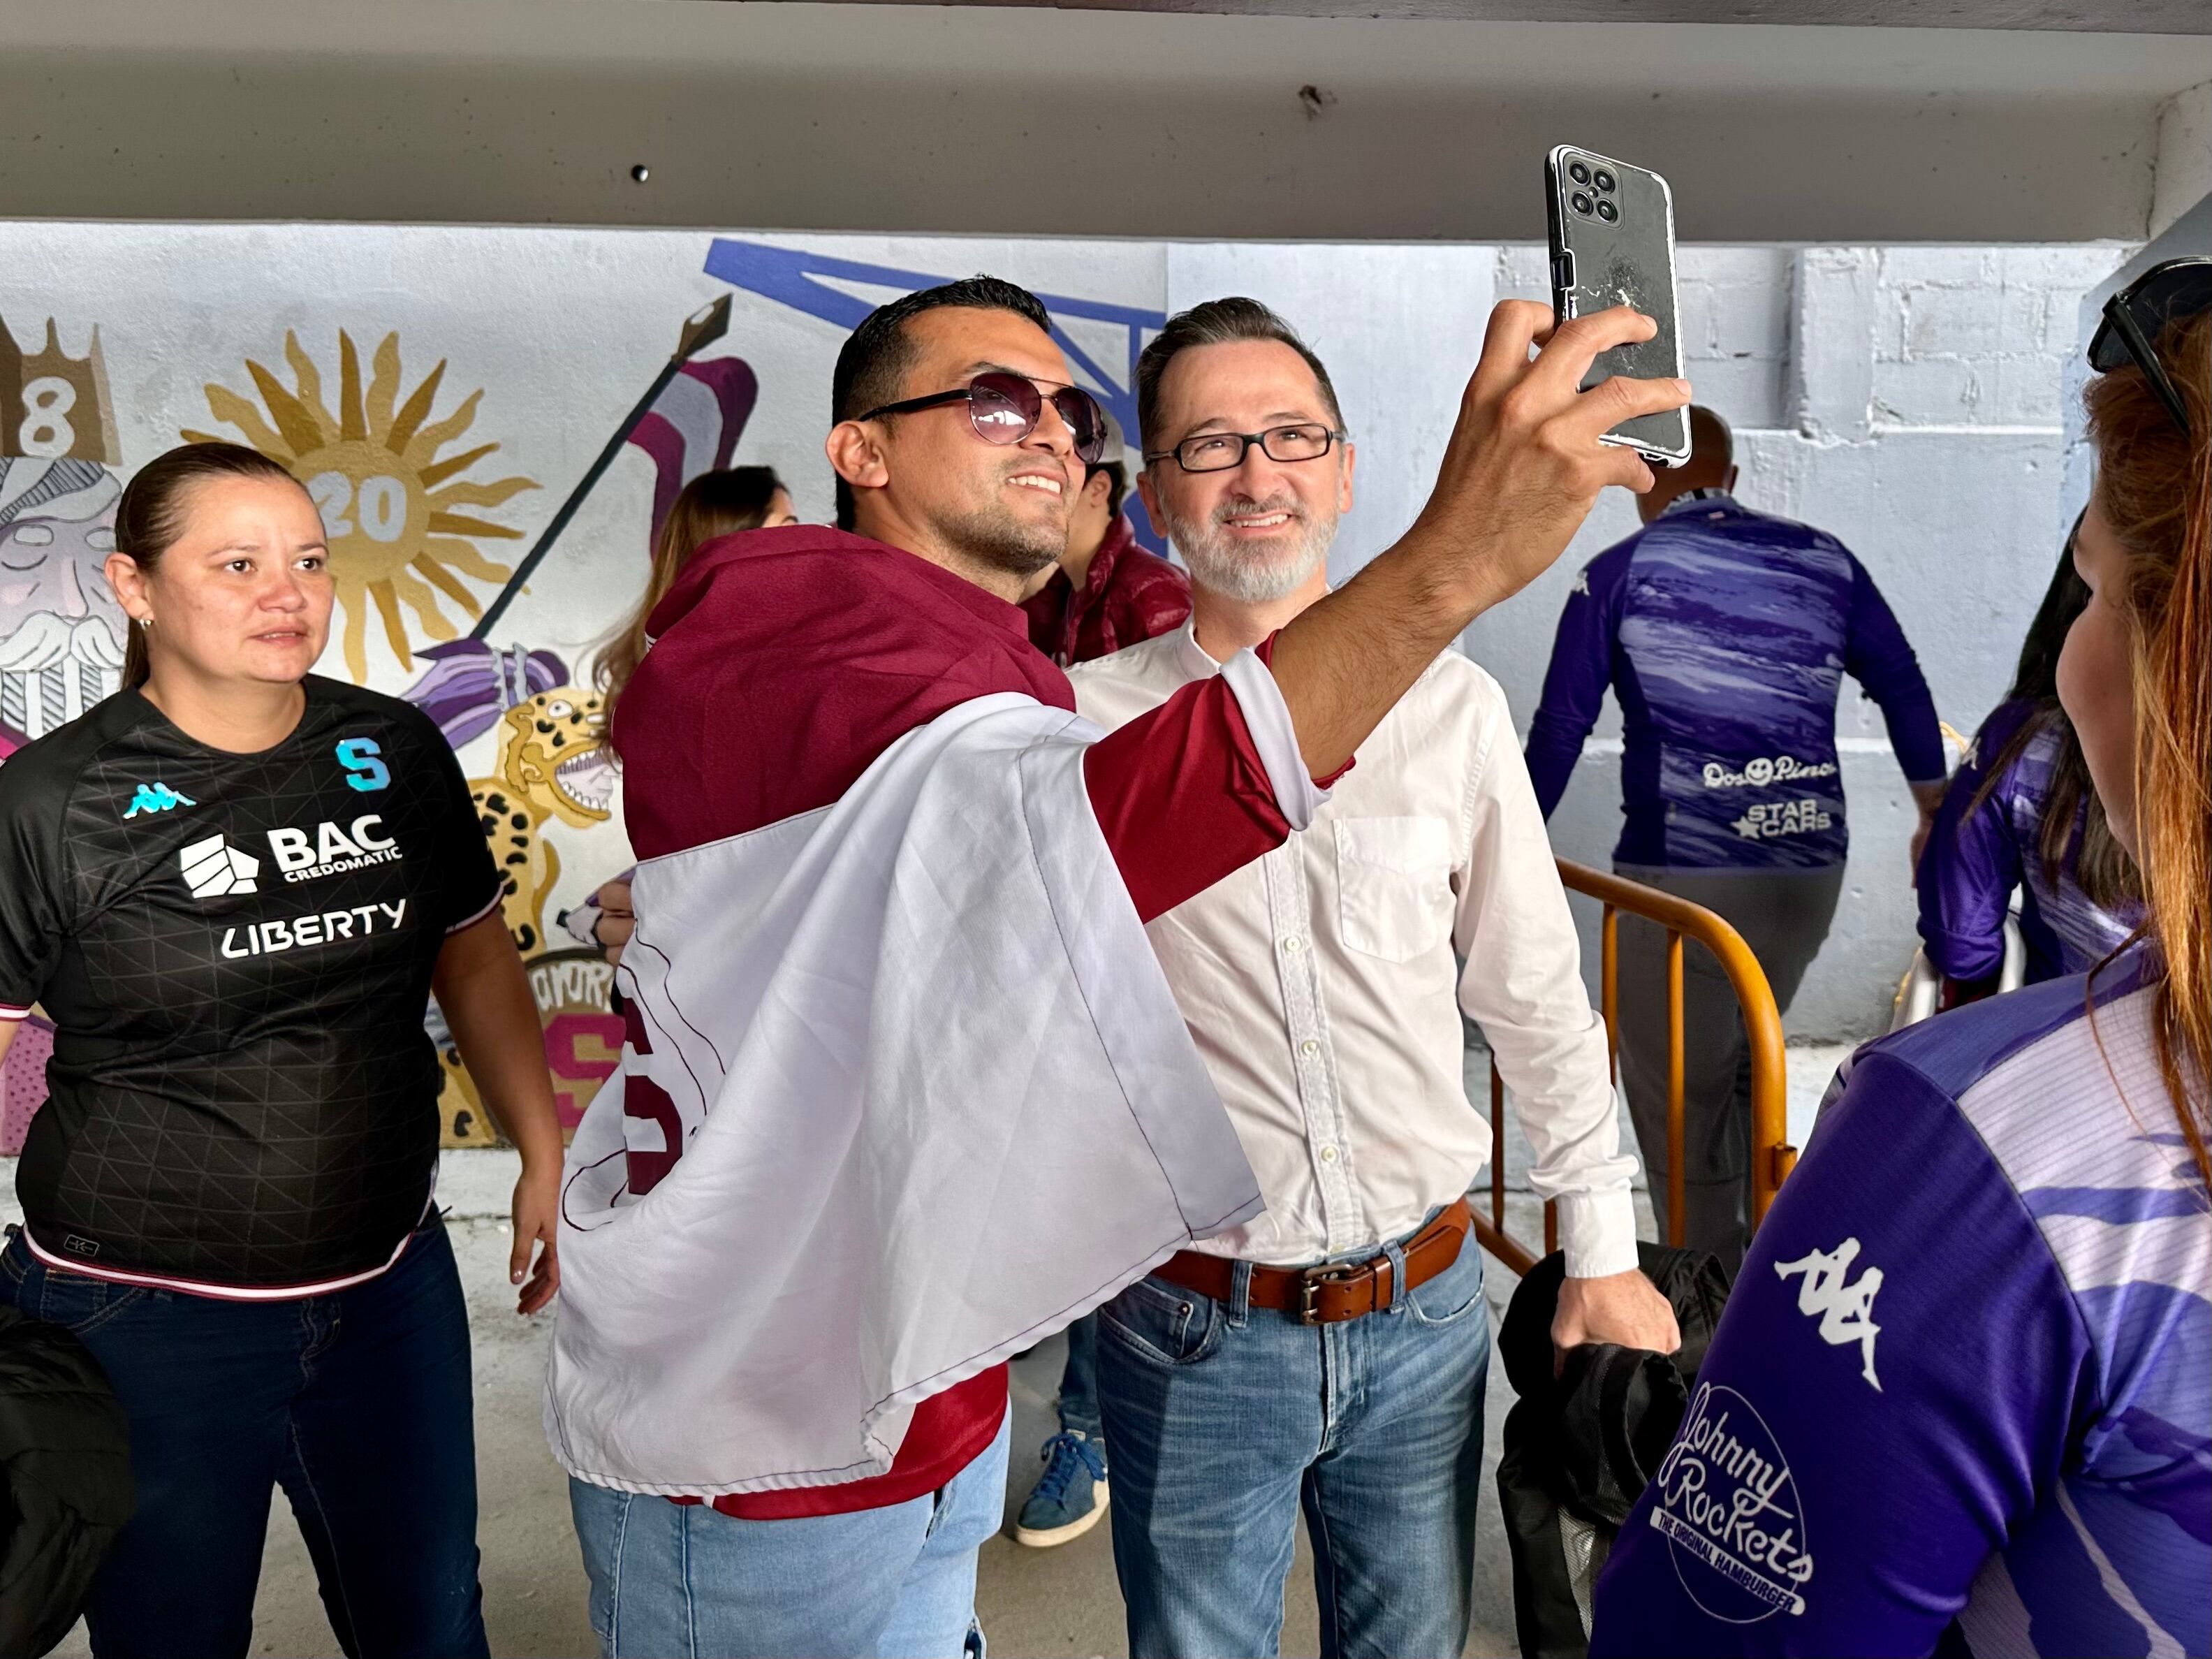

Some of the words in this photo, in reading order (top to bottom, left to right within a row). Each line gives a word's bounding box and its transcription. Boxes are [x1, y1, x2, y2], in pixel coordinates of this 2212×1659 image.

[20, 376, 76, 457] 8
[307, 470, 407, 543] 20
[335, 737, 391, 792] S
[1703, 762, 1748, 788] Dos
[1748, 799, 1816, 822] STAR
[1761, 811, 1831, 837] CARS
[267, 814, 396, 873] BAC
[284, 846, 403, 883] CREDOMATIC
[221, 898, 406, 959] LIBERTY
[1657, 1381, 1794, 1519] Johnny
[1664, 1457, 1814, 1582] Rockets
[1657, 1512, 1675, 1535] THE
[1673, 1520, 1713, 1563] ORIGINAL
[1714, 1552, 1797, 1612] HAMBURGER
